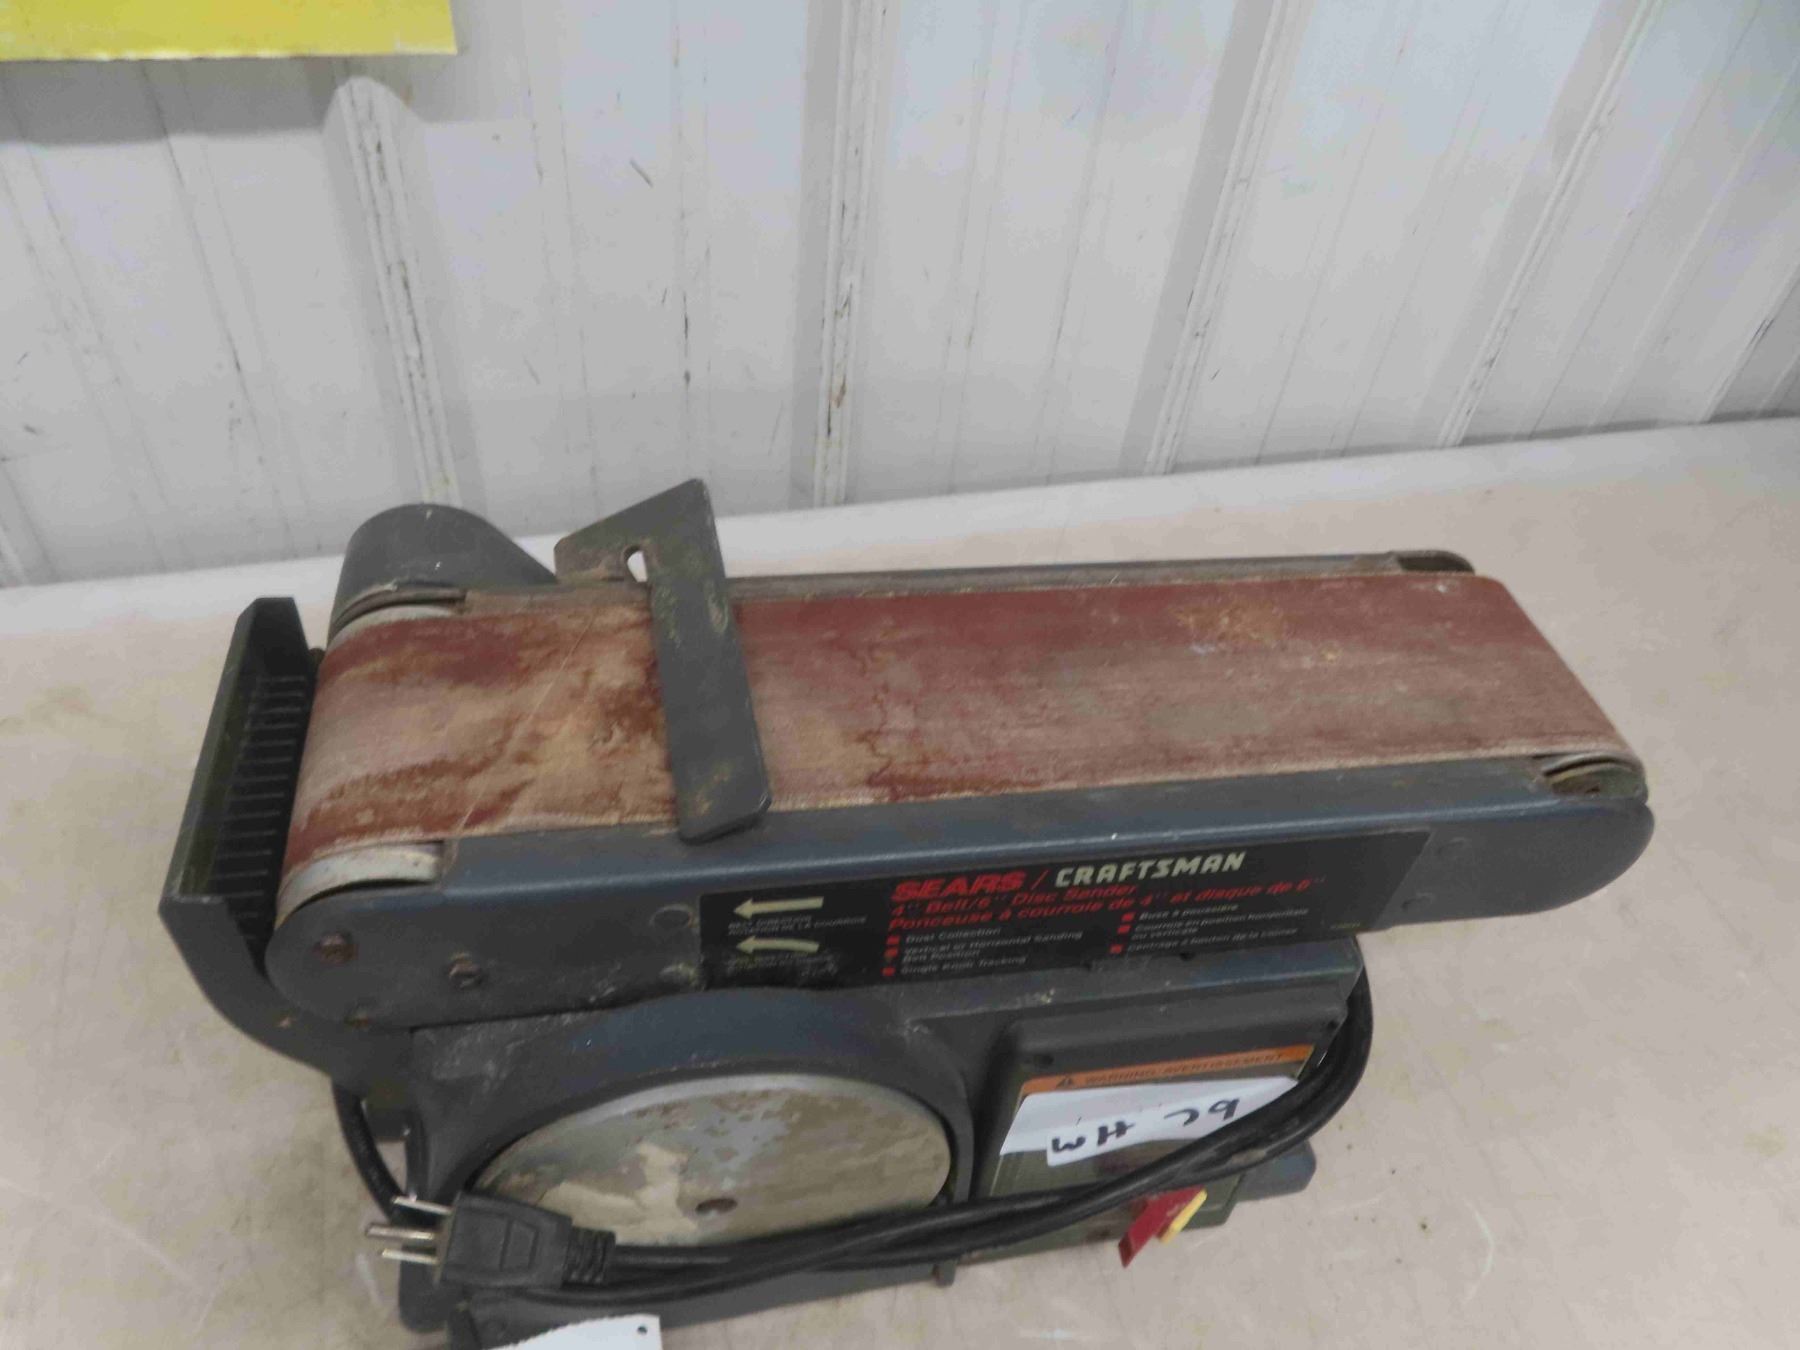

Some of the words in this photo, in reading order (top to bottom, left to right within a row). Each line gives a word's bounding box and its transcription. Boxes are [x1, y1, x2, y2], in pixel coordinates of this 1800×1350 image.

[891, 870, 1027, 900] SEARS
[1055, 852, 1246, 888] CRAFTSMAN
[889, 911, 993, 931] Ponceuse
